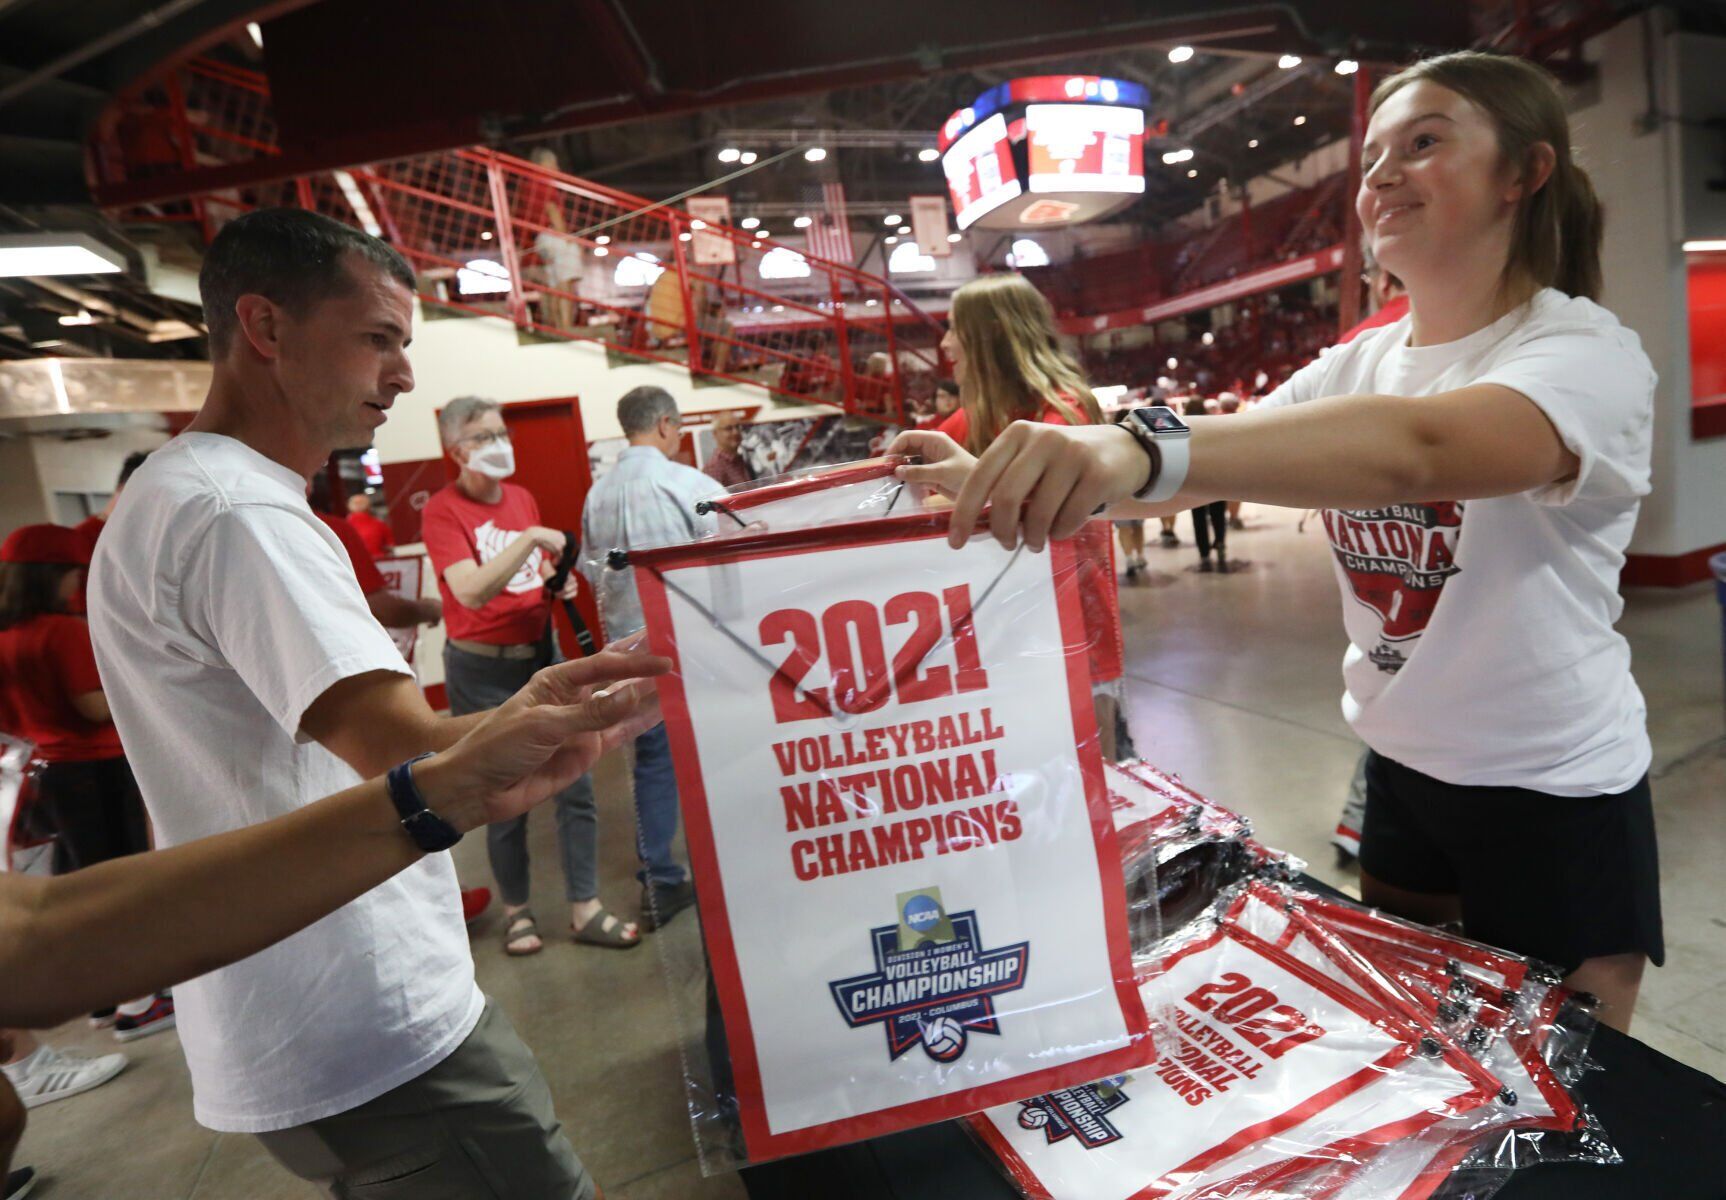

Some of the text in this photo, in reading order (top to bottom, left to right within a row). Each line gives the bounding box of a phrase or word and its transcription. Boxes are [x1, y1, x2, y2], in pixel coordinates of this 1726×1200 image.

[1321, 509, 1456, 571] NATIONA
[1346, 505, 1426, 523] EYBALL
[383, 570, 402, 590] 21
[758, 583, 988, 724] 2021
[772, 707, 1004, 777] VOLLEYBALL
[780, 749, 1013, 833] NATIONAL
[790, 800, 1023, 882] CHAMPIONS
[908, 910, 940, 925] NCAA
[852, 957, 1019, 1014] CHAMPIONSHIP
[886, 950, 976, 981] VOLLEYBALL
[898, 998, 979, 1024] 2021 COLUMBUS
[1184, 972, 1327, 1060] 2021
[1173, 1037, 1240, 1093] IONAL
[1175, 1008, 1264, 1080] OLLEYBALL
[1073, 1088, 1102, 1115] EYBALL
[1154, 1057, 1213, 1107] PIONS
[1054, 1091, 1109, 1140] PIONSHIP
